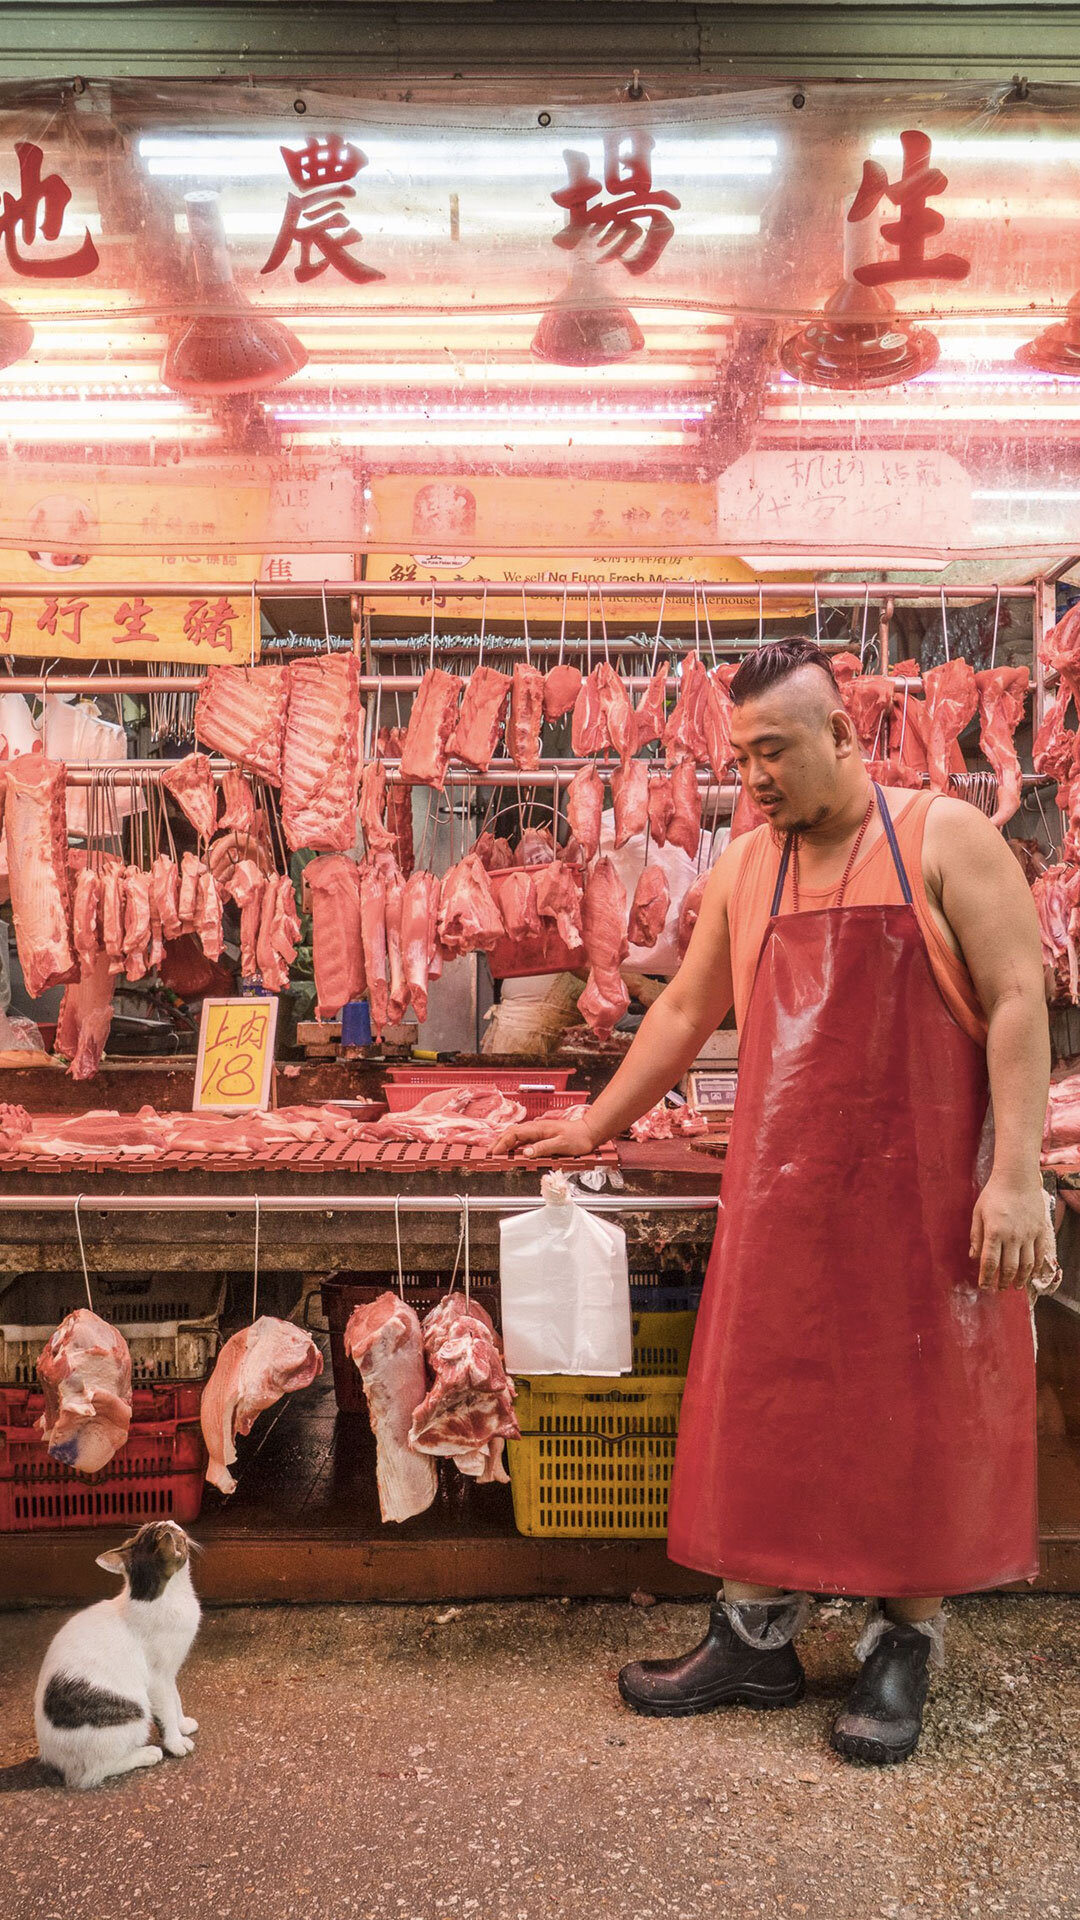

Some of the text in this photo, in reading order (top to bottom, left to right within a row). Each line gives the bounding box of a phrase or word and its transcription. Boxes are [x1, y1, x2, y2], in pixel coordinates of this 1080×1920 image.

[503, 571, 522, 582] We
[524, 571, 545, 582] sell
[609, 572, 645, 583] Fresh
[206, 1010, 268, 1053] 上肉
[201, 1053, 255, 1096] 18
